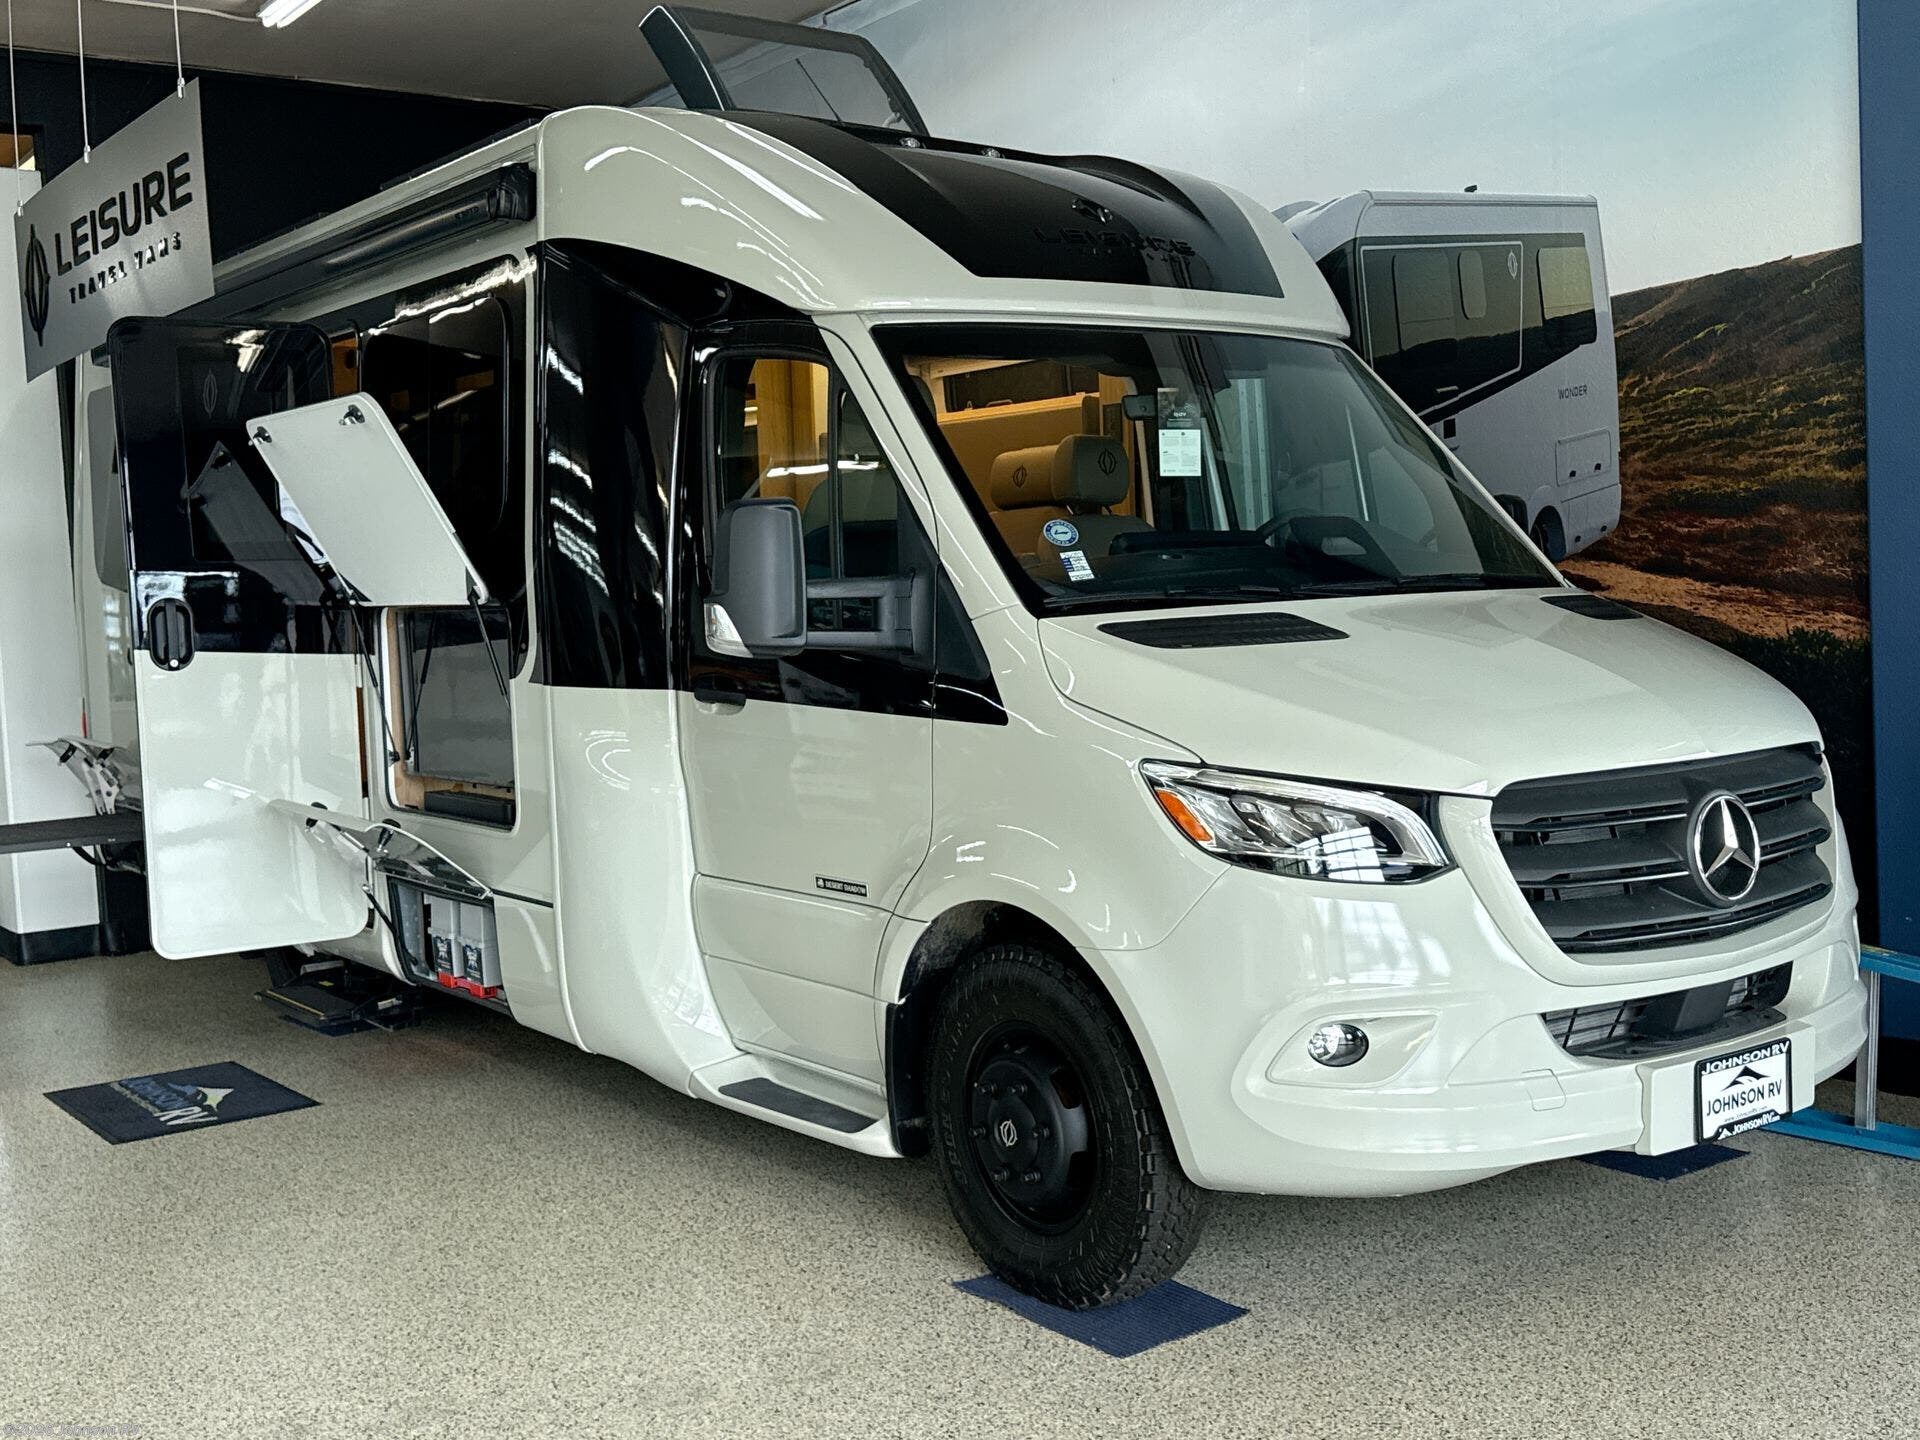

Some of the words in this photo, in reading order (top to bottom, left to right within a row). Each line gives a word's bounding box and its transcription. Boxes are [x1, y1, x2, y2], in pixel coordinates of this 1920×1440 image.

[54, 151, 193, 277] LEISURE
[68, 260, 128, 304] TRAVEL
[133, 231, 182, 270] VANS
[1557, 384, 1588, 400] WONDER
[825, 880, 843, 890] DESERT
[1701, 1047, 1771, 1075] JOHNSON
[1771, 1041, 1789, 1055] RV
[1706, 1084, 1765, 1116] JOHNSON
[1768, 1079, 1783, 1099] RV
[153, 1105, 219, 1126] RV
